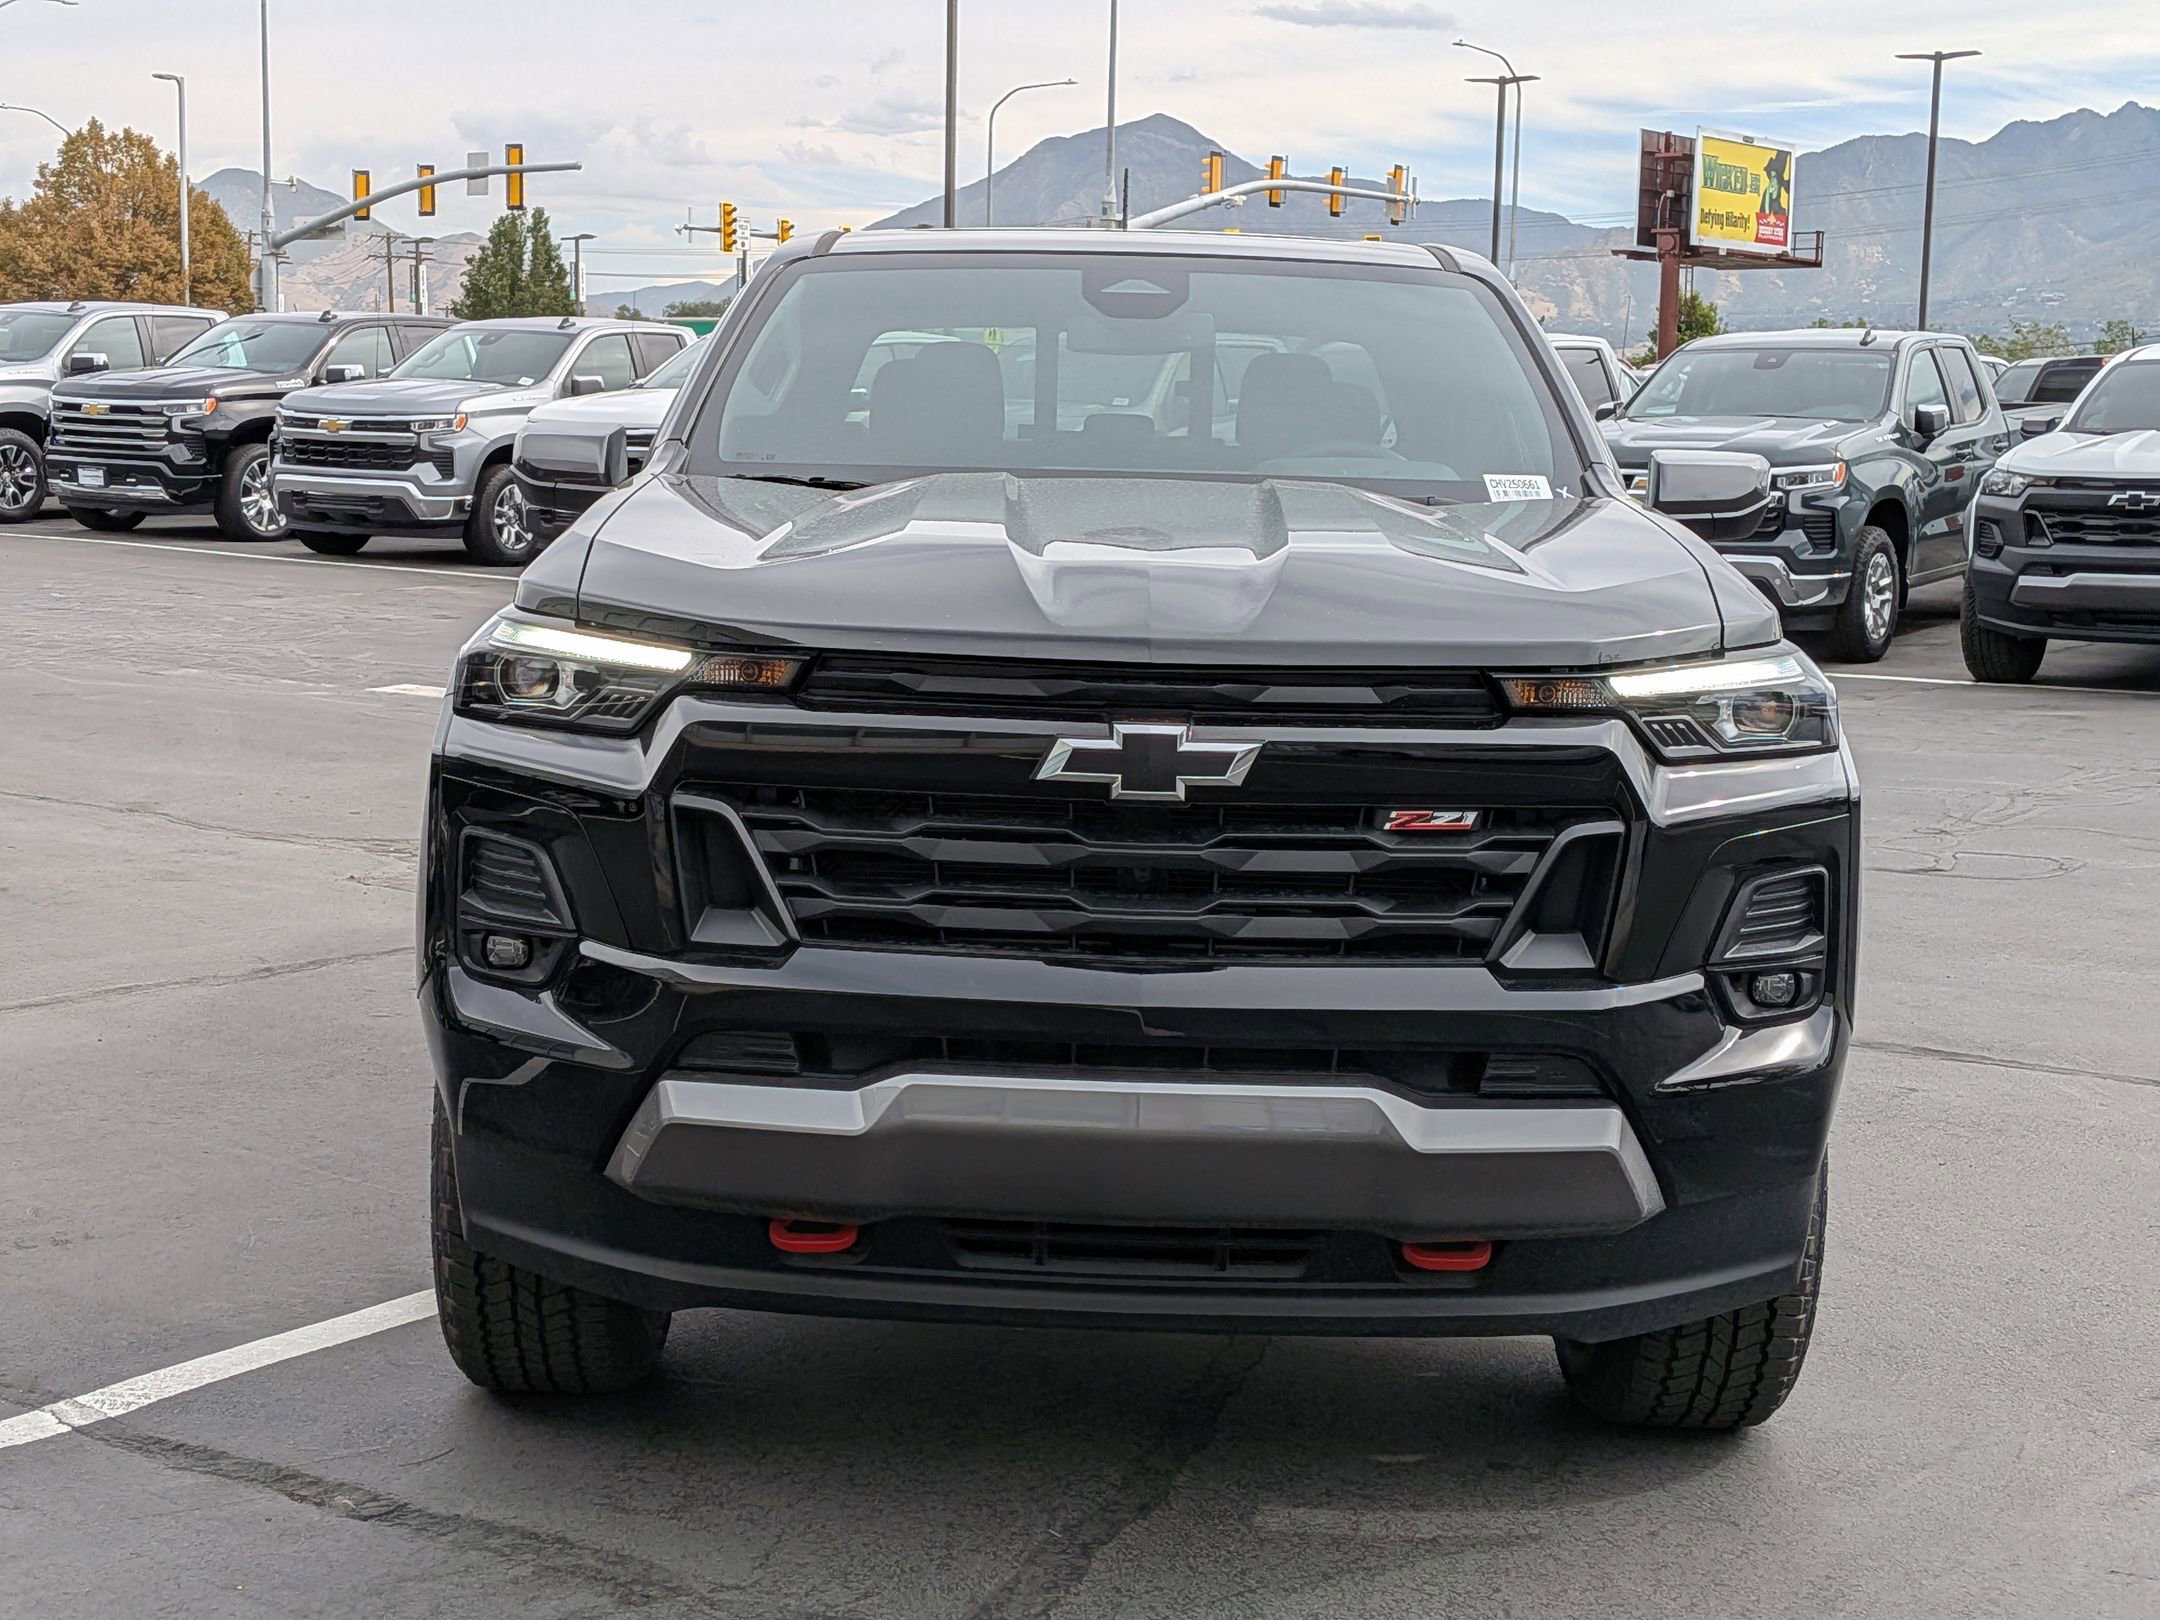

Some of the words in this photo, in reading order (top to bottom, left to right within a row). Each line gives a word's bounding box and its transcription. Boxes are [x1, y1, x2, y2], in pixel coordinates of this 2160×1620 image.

[1700, 207, 1724, 230] Defying
[1725, 211, 1751, 233] Hilarity!
[1489, 478, 1541, 490] CHV250661
[1383, 811, 1478, 830] Z71
